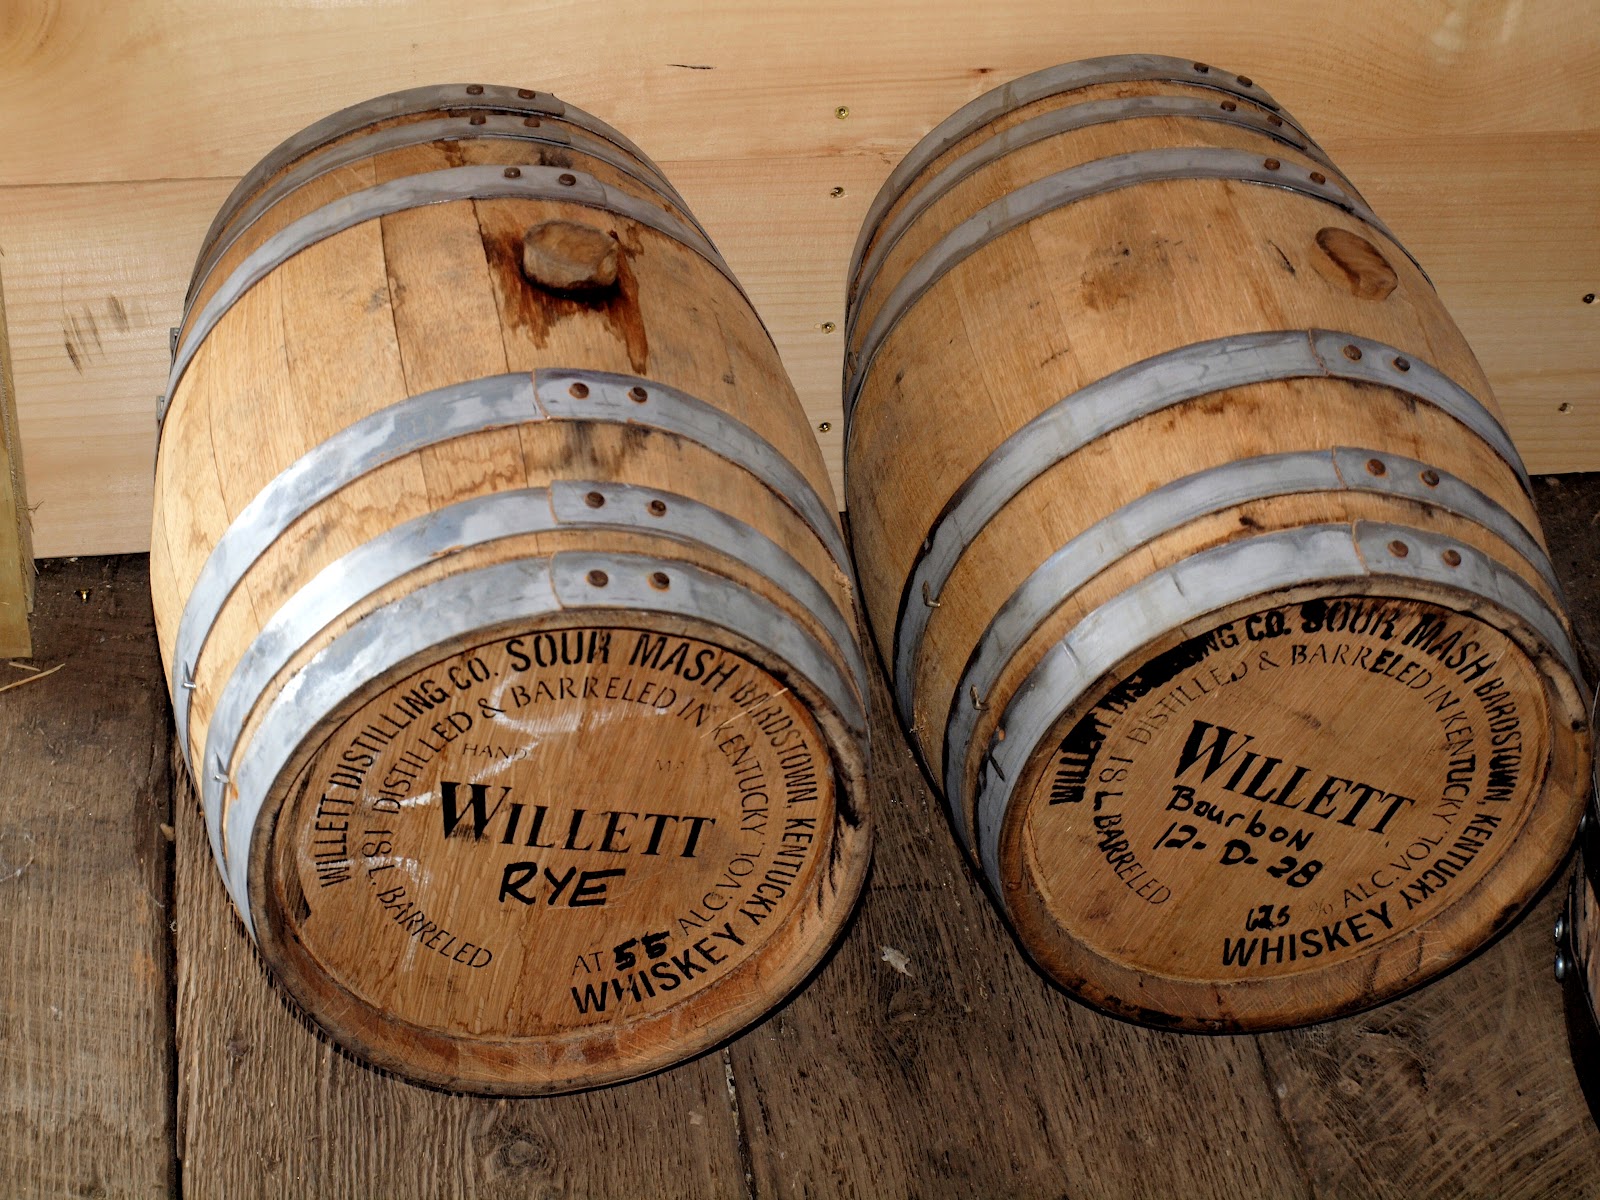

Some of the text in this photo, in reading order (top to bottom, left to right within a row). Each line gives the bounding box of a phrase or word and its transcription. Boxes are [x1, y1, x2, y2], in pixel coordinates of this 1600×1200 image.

[505, 631, 740, 693] SOUR MASH
[1245, 610, 1292, 641] CO.
[1258, 650, 1280, 672] &
[1291, 643, 1432, 690] BARRELED
[1300, 600, 1498, 684] SOUR MASH
[1125, 661, 1248, 746] DISTILLED
[1424, 684, 1461, 713] IN
[314, 657, 499, 888] WILLETT DISTILLING CO.
[372, 711, 474, 815] DISTILLED
[477, 697, 507, 719] &
[511, 676, 677, 709] BARRELED
[676, 697, 711, 728] IN
[711, 723, 769, 836] KENTUCKY
[462, 742, 528, 761] HAND
[1173, 719, 1416, 835] WILLETT
[1432, 710, 1477, 825] KENTUCKY
[440, 781, 717, 858] WILLETT
[729, 680, 819, 926] BARDSTOWN, KENTUCKY
[498, 861, 626, 908] RYE
[1092, 813, 1172, 905] BARRELED
[1398, 812, 1503, 911] KENTUCKY
[376, 885, 493, 969] BARRELED
[570, 922, 746, 1014] WHISKEY
[571, 951, 604, 976] AT
[1222, 901, 1395, 967] WHISKEY
